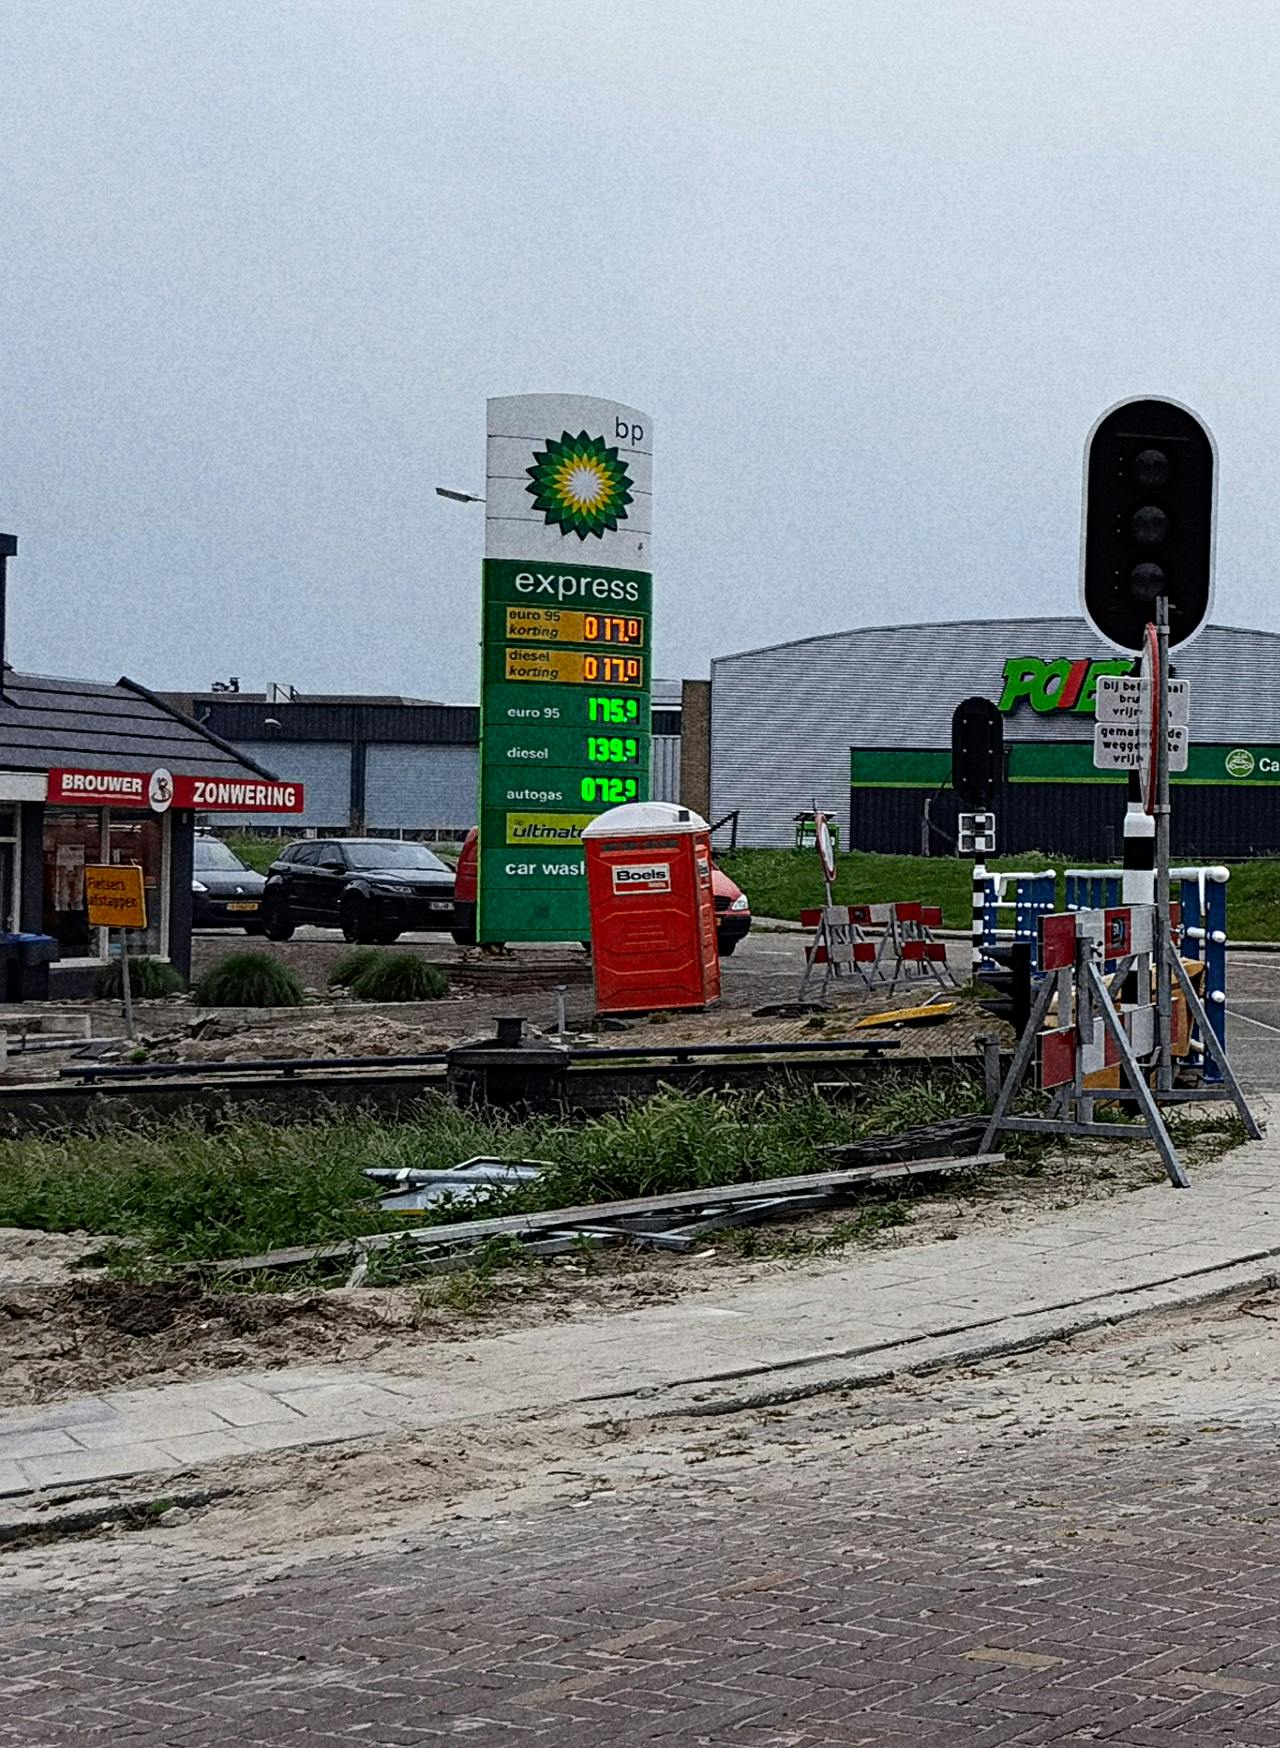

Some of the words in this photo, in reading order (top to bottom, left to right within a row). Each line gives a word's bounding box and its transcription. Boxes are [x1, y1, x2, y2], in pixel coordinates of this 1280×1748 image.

[615, 415, 644, 447] bp
[514, 572, 640, 602] express
[508, 610, 541, 621] euro
[544, 611, 561, 622] 95
[508, 624, 559, 639] korting
[508, 650, 550, 662] diesel
[508, 665, 559, 680] korting
[1103, 681, 1119, 693] bij
[507, 708, 541, 718] euro
[543, 707, 561, 719] 95
[507, 747, 549, 759] diesel
[61, 773, 143, 793] BROUWER
[192, 781, 296, 807] ZONWERING
[506, 789, 563, 802] autogas
[505, 863, 537, 876] car
[616, 869, 667, 881] Boels
